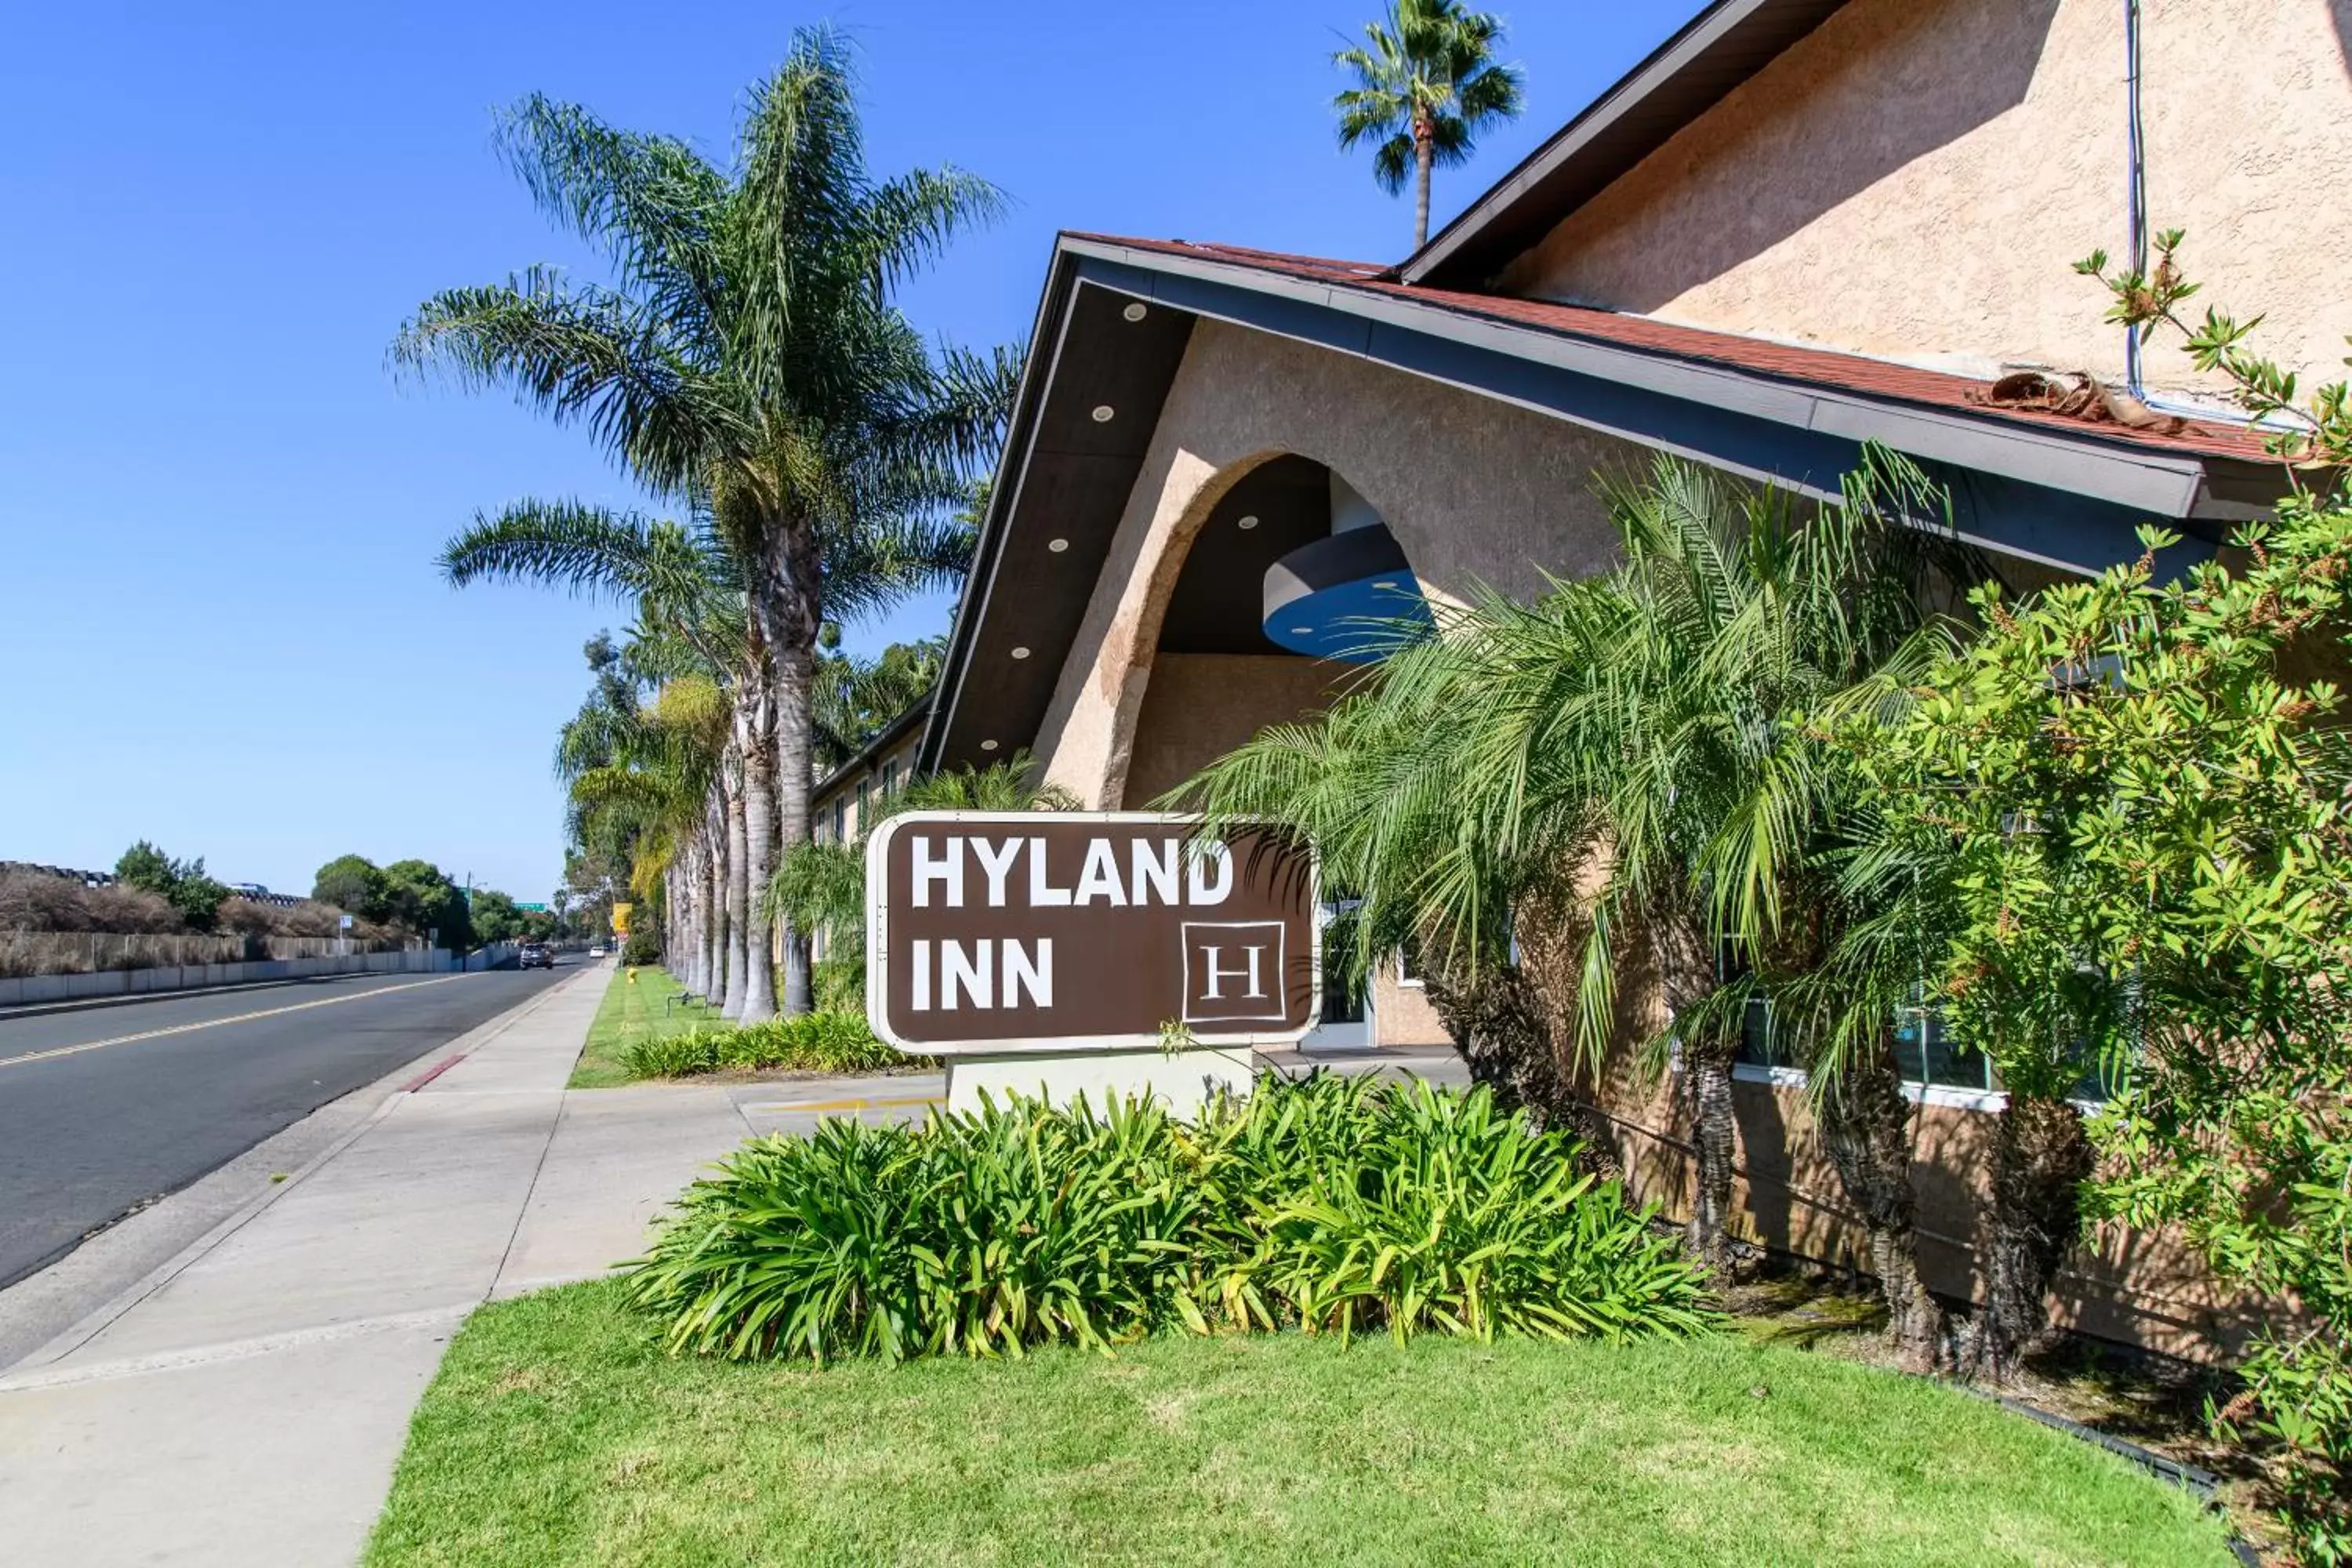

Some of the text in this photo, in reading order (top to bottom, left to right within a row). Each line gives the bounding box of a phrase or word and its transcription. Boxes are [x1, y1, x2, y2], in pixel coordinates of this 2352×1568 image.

[912, 836, 1233, 908] HYLAND
[912, 938, 1053, 1011] INN
[1200, 946, 1268, 1000] H
